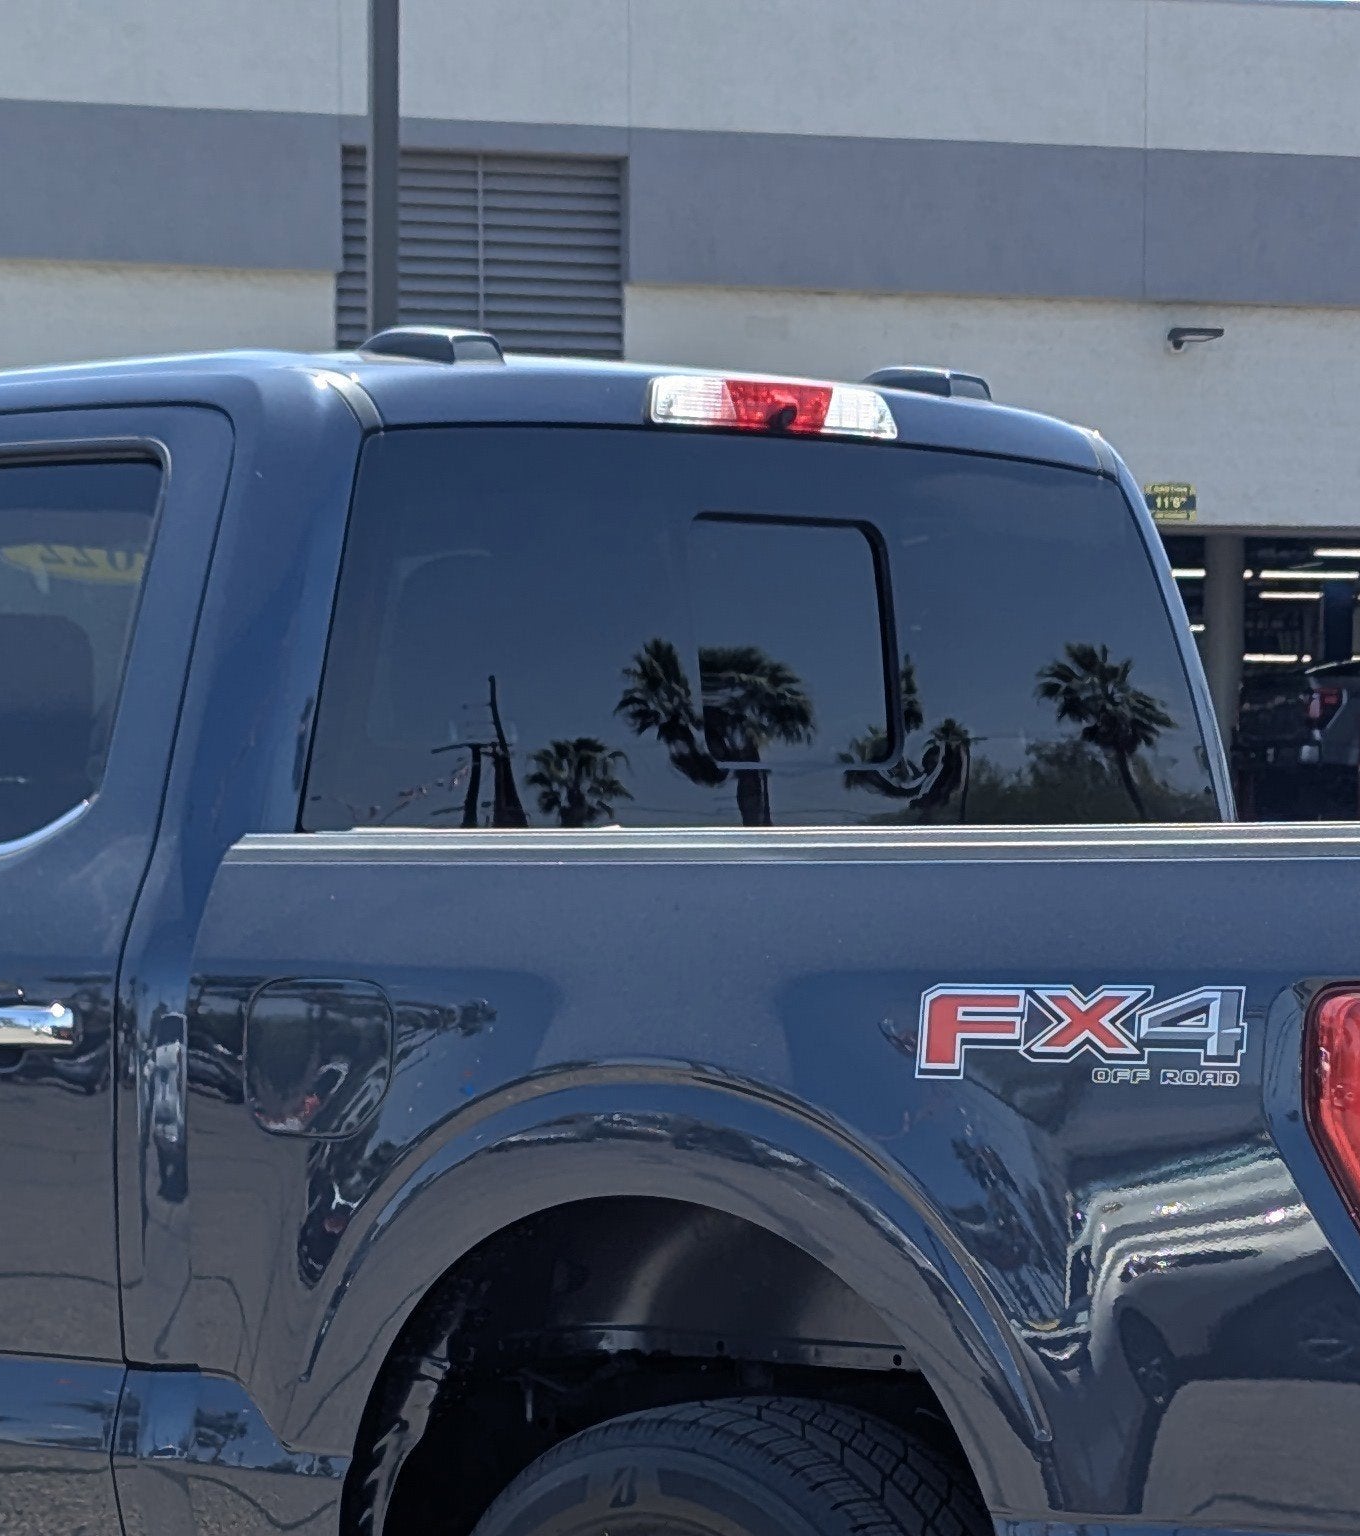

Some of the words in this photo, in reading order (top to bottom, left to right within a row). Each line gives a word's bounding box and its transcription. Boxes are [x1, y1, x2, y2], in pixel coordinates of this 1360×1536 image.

[914, 983, 1247, 1080] FX4
[1091, 1067, 1151, 1085] OFF
[1159, 1068, 1240, 1086] ROAD
